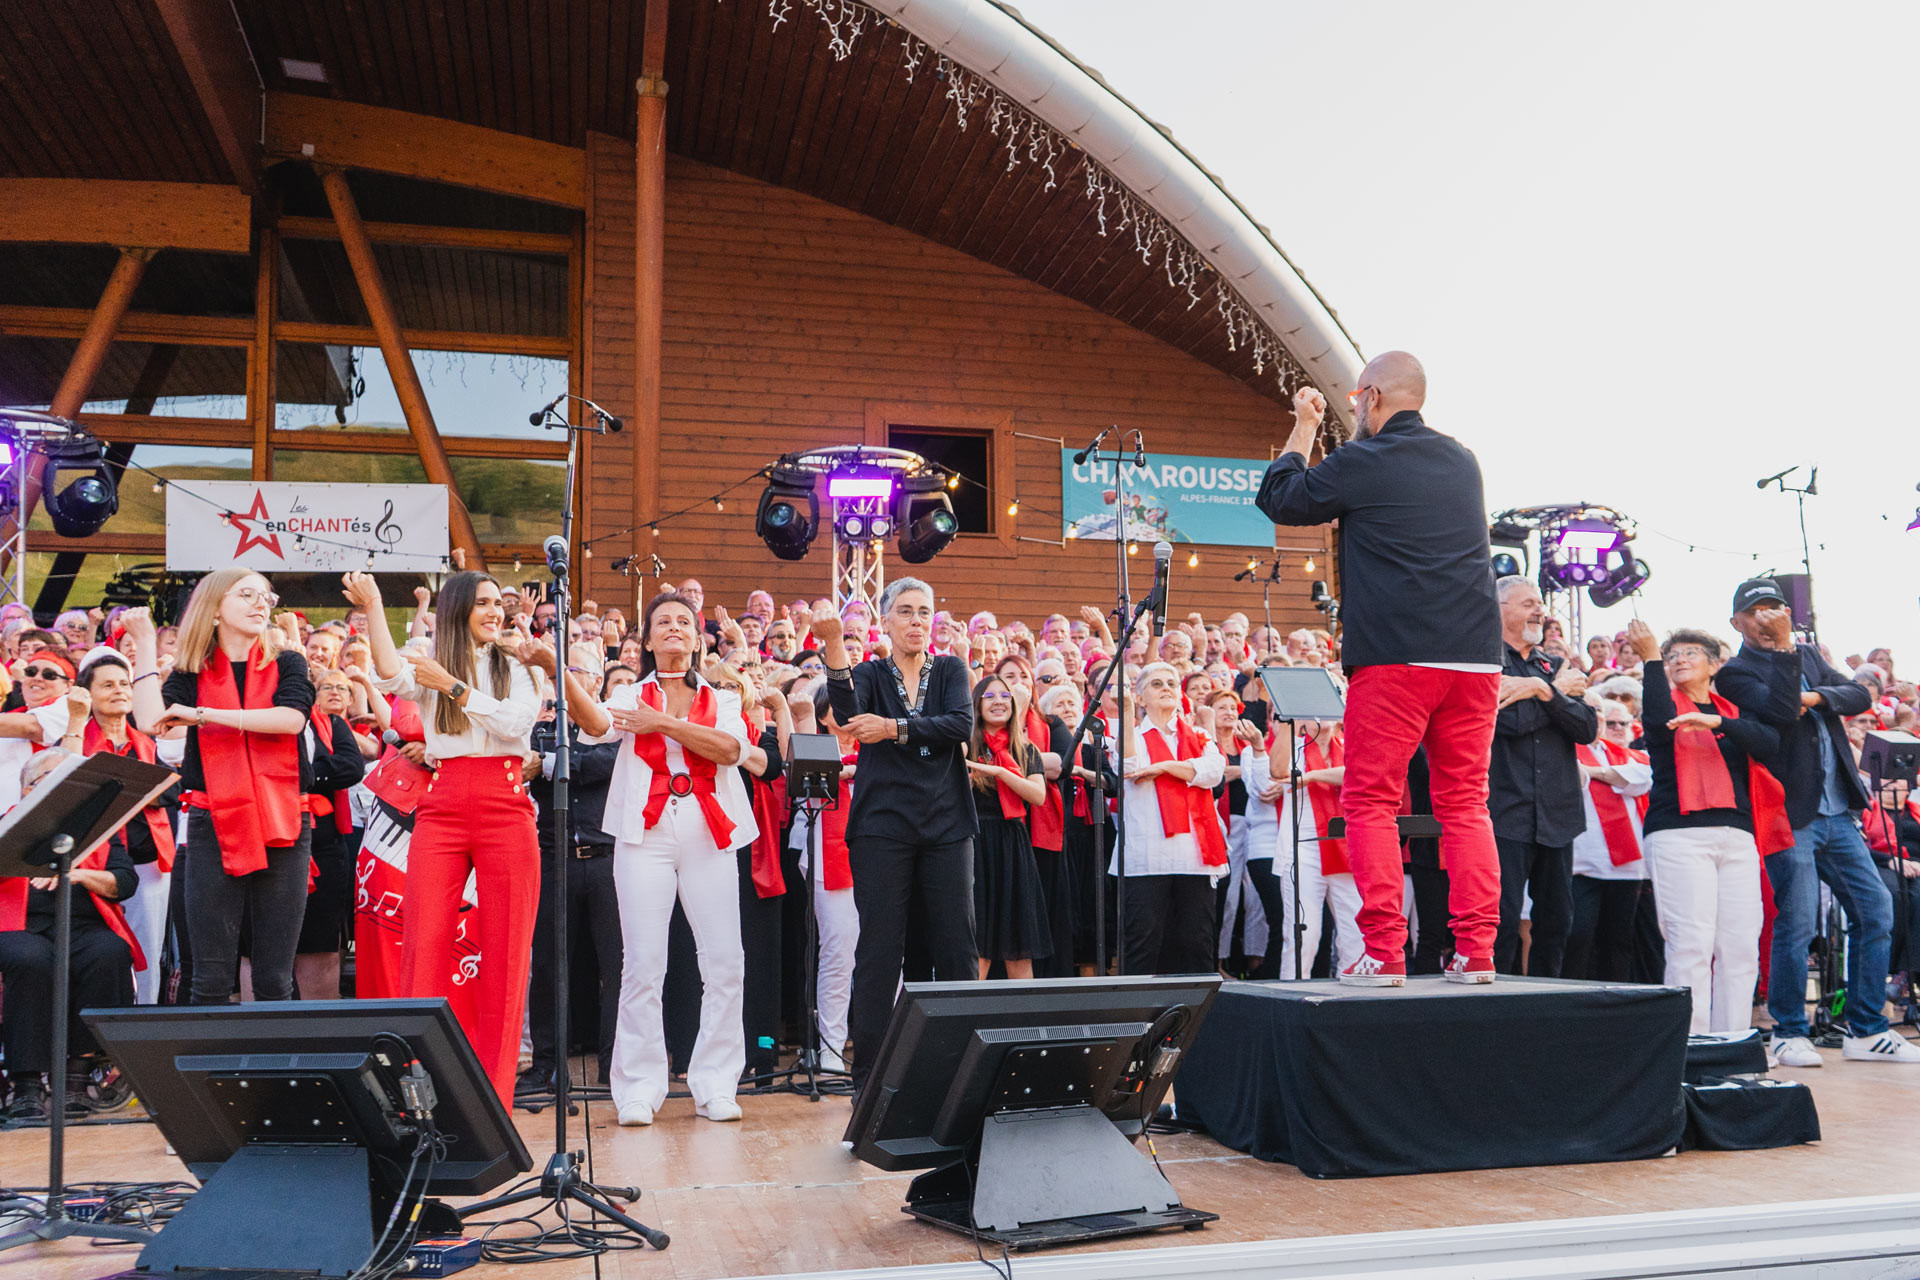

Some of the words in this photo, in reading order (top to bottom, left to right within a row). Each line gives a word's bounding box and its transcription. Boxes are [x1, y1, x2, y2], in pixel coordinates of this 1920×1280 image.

[1072, 462, 1263, 492] CHAMROUSSE
[290, 495, 309, 513] Les
[1180, 493, 1240, 505] ALPES-FRANCE
[266, 517, 371, 532] enCHANTés
